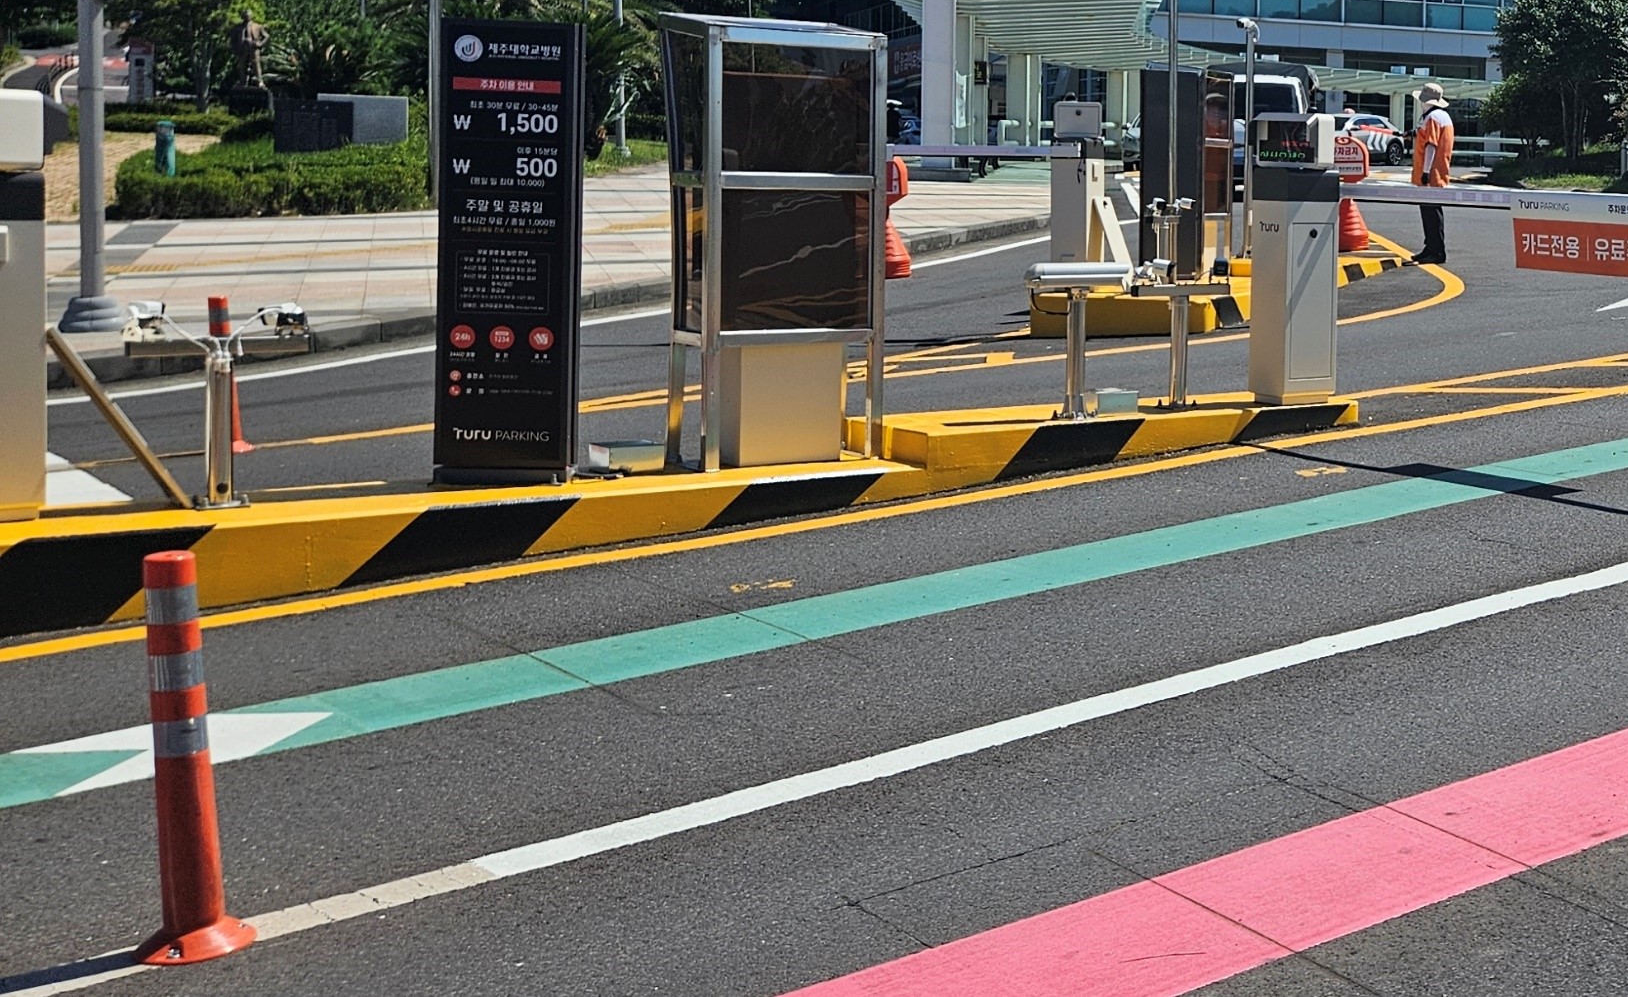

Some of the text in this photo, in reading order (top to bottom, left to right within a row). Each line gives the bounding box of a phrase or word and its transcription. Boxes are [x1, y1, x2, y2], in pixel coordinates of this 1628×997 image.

[488, 43, 561, 57] 제주대학교병원
[480, 79, 498, 90] 주차
[497, 112, 559, 135] 1,500
[516, 157, 558, 177] 500
[466, 198, 543, 214] 주말 및 공휴일
[1540, 202, 1570, 212] PARKING
[1522, 233, 1580, 259] 카드전용
[495, 430, 550, 442] PARKING
